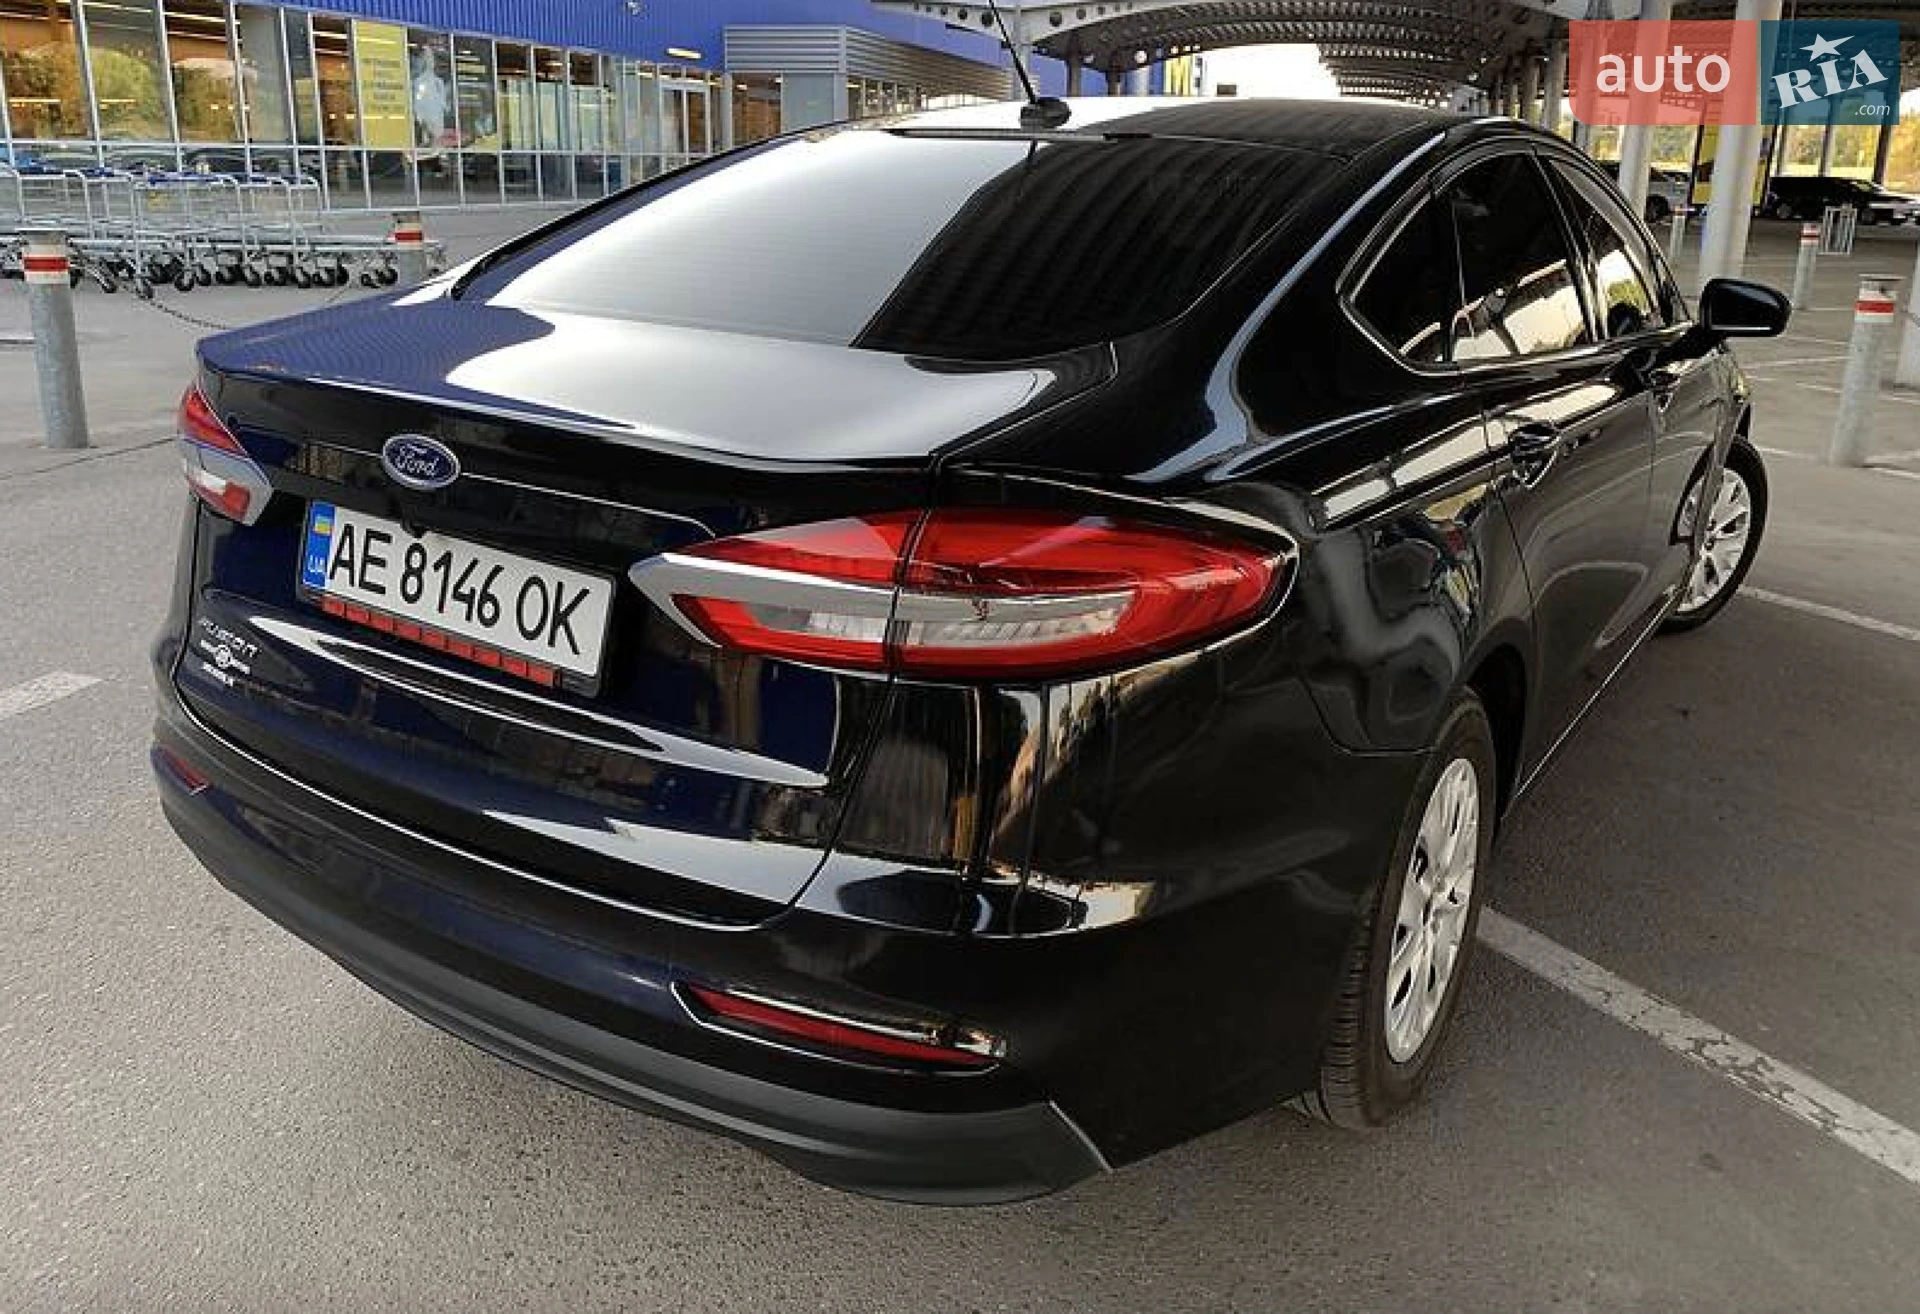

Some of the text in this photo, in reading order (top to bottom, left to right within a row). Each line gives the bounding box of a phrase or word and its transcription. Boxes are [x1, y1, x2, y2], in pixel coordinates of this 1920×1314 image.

[395, 443, 440, 476] Ford
[329, 523, 591, 655] AE 8146 OK
